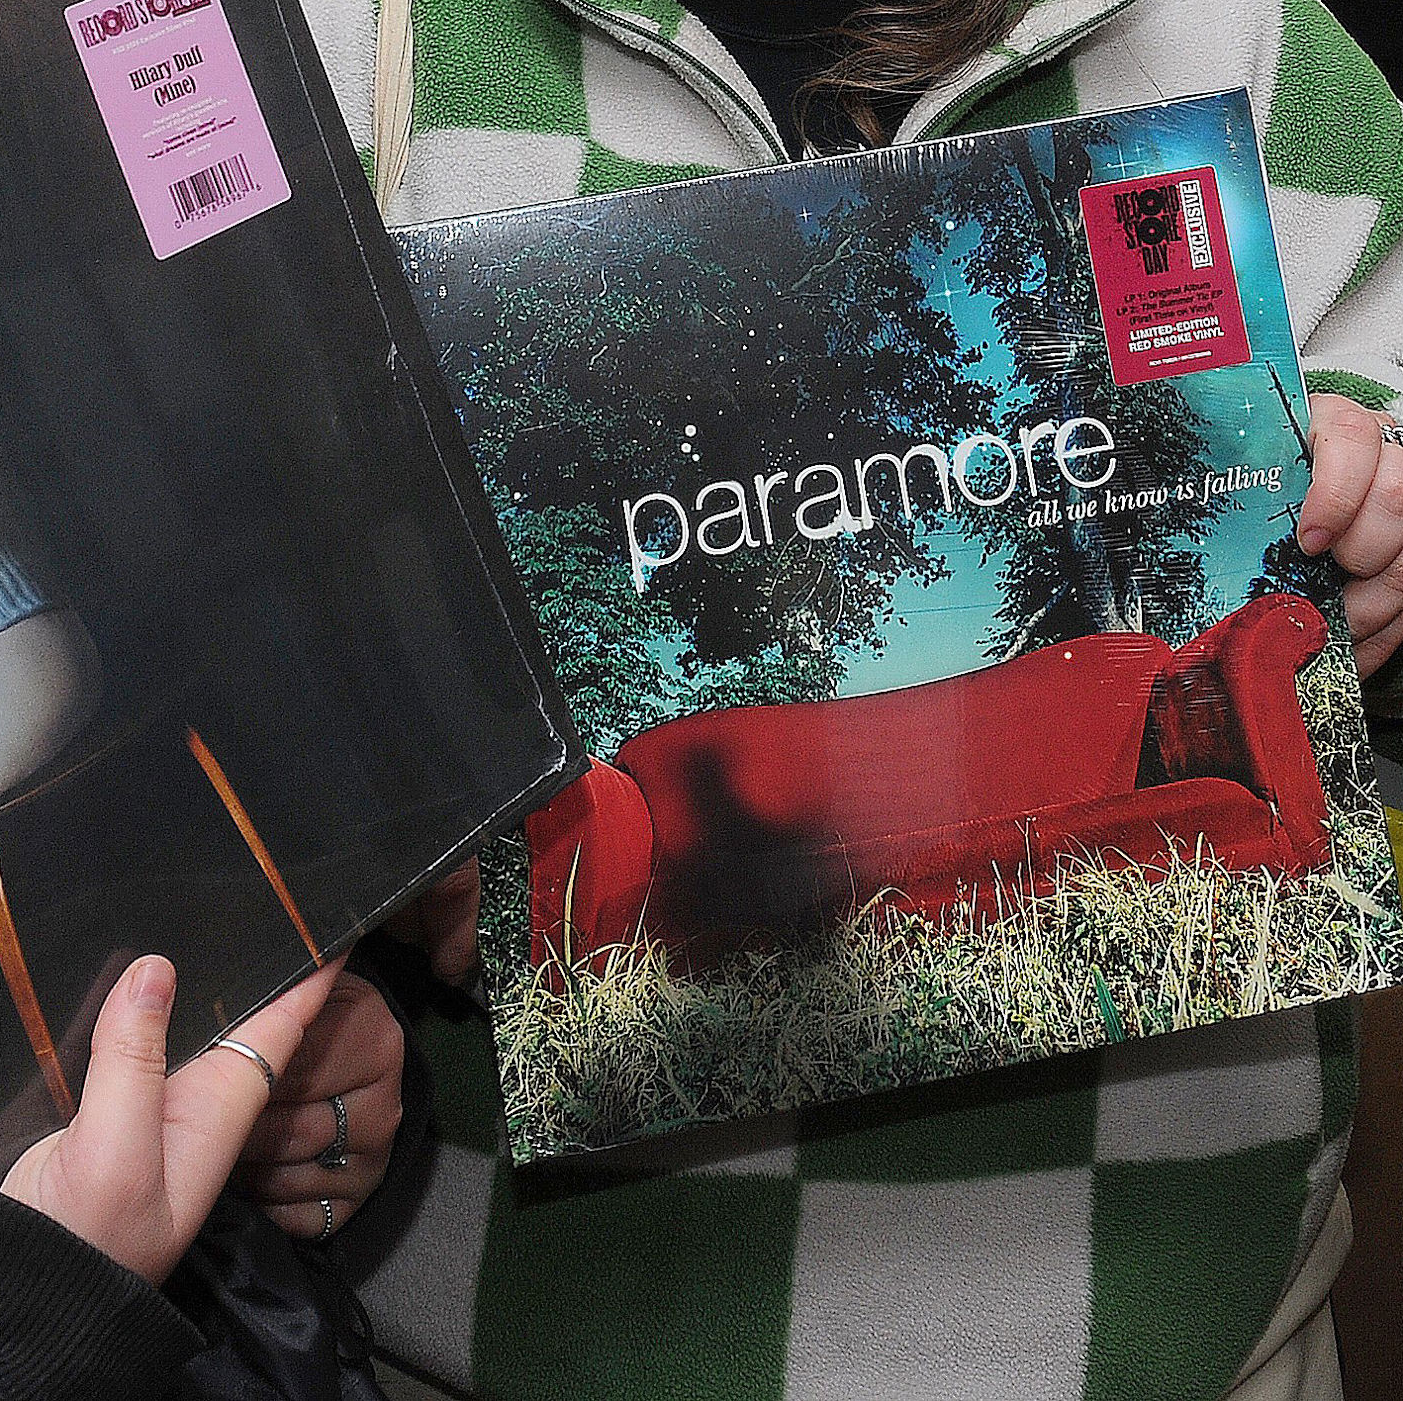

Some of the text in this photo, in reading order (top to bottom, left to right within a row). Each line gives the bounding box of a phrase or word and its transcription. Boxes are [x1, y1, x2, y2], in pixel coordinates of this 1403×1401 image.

[78, 3, 138, 49] RECORD
[128, 45, 205, 92] Hilary Duff
[153, 78, 198, 108] (Mine)
[1115, 186, 1182, 226] RECORD
[1180, 178, 1211, 270] EXCLUSIVE
[1123, 213, 1184, 251] STORE
[1139, 245, 1173, 276] DAY
[1128, 325, 1226, 353] RED SMOKE VINYL
[1130, 315, 1220, 341] LIMITED-EDITION
[621, 415, 1117, 593] paramore
[1027, 460, 1284, 529] all we know is falling
